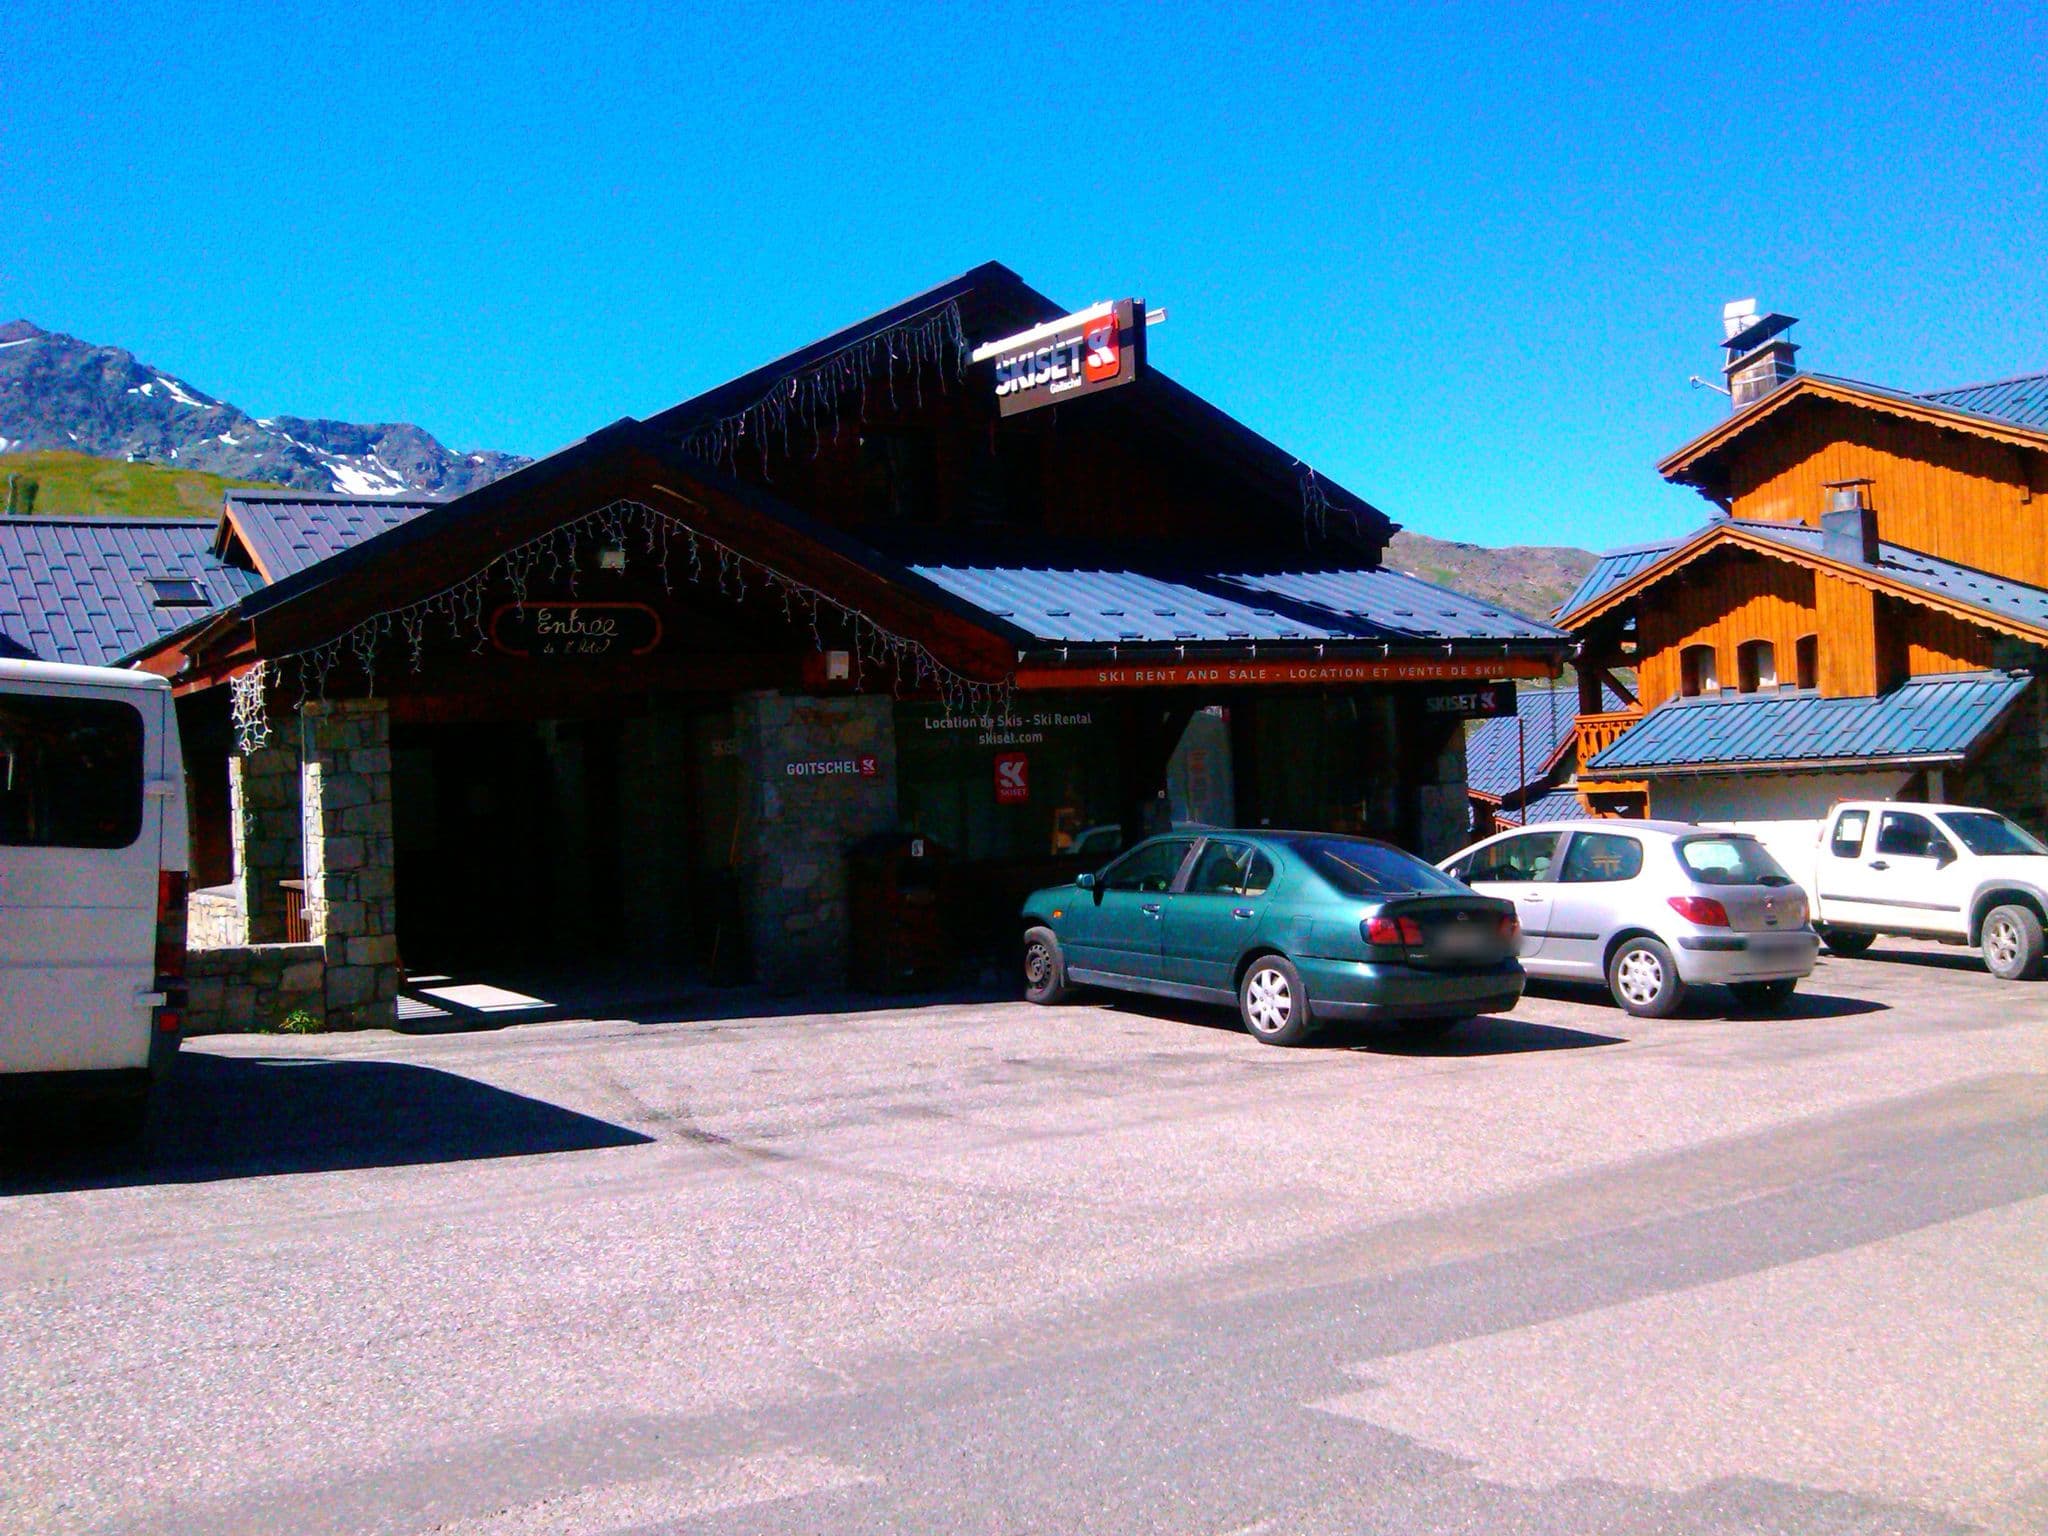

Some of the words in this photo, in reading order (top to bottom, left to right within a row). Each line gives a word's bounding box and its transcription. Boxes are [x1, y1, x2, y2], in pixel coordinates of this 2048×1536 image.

[995, 335, 1083, 396] SKISET
[1099, 671, 1125, 682] SKI
[1135, 670, 1176, 681] RENT
[1186, 669, 1219, 680] AND
[1228, 669, 1266, 679] SALE
[1289, 667, 1364, 679] LOCATION
[1372, 667, 1390, 677] ET
[1399, 666, 1442, 677] VENTE
[1451, 666, 1467, 676] DE
[1474, 665, 1504, 675] SKIS
[1426, 693, 1477, 711] SKISET
[925, 716, 976, 729] Location
[997, 714, 1022, 727] Skis
[1033, 712, 1051, 726] Ski
[1055, 712, 1091, 725] Rental
[979, 732, 1043, 745] skiset.com
[786, 761, 859, 775] GOITSCHEL
